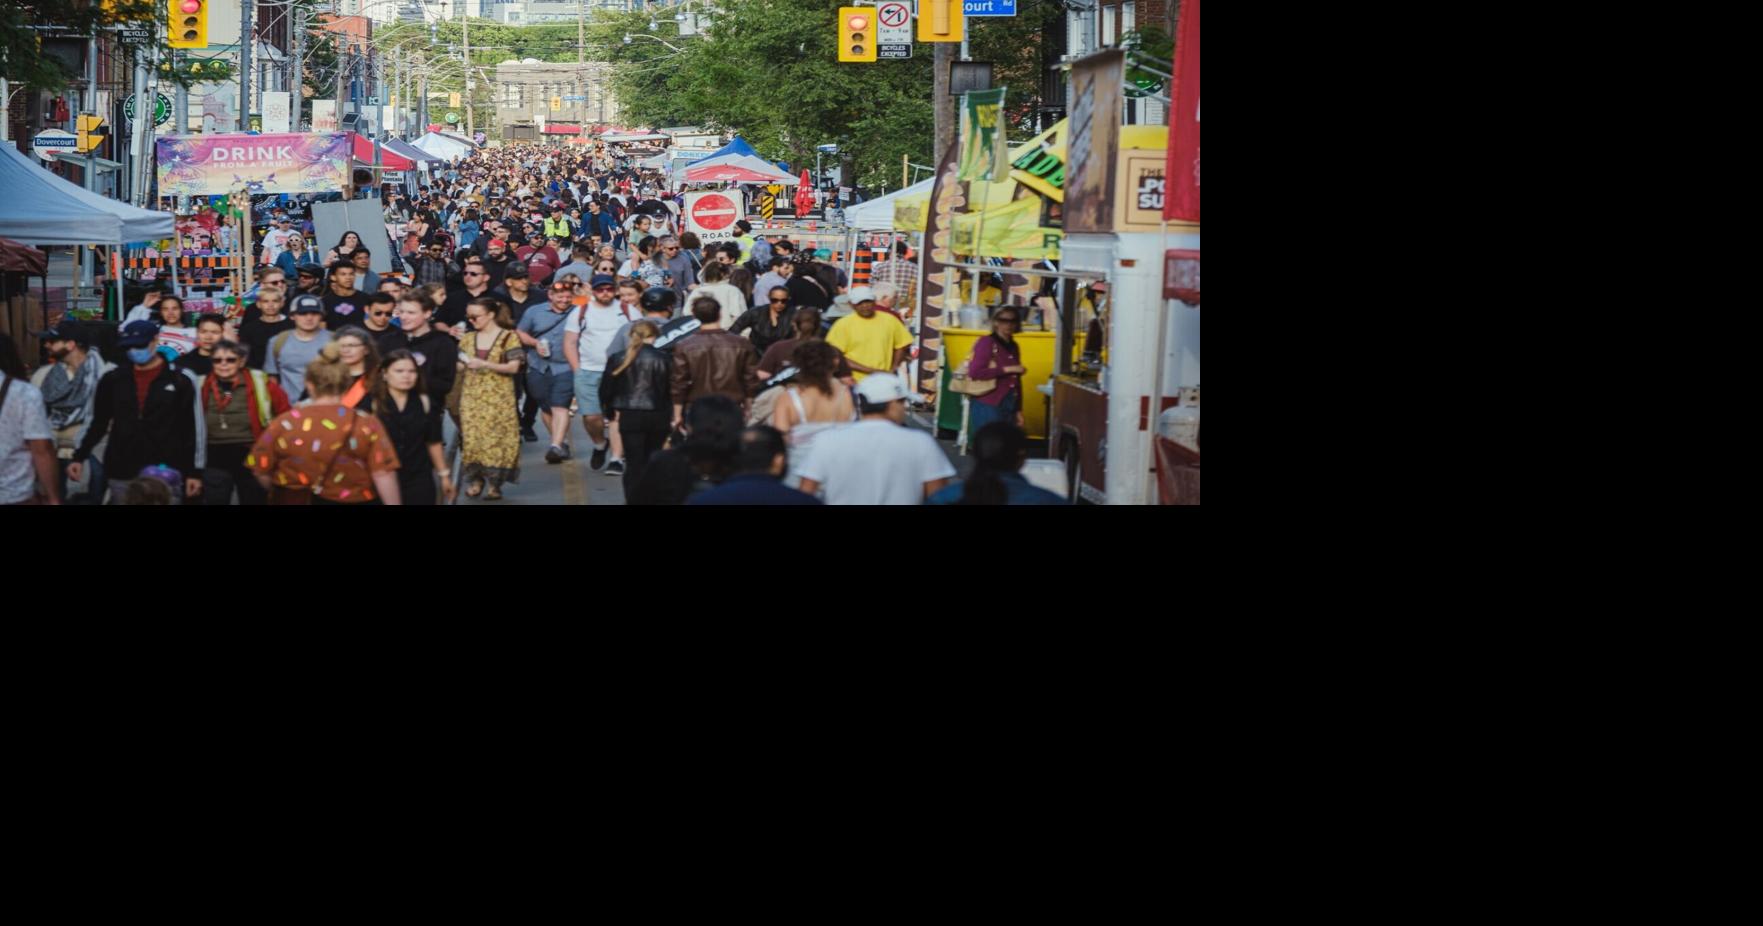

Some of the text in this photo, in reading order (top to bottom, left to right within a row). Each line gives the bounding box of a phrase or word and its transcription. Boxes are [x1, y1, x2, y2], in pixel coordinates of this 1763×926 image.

[212, 145, 292, 161] DRINK
[1140, 168, 1165, 176] THE
[702, 231, 731, 239] ROAD
